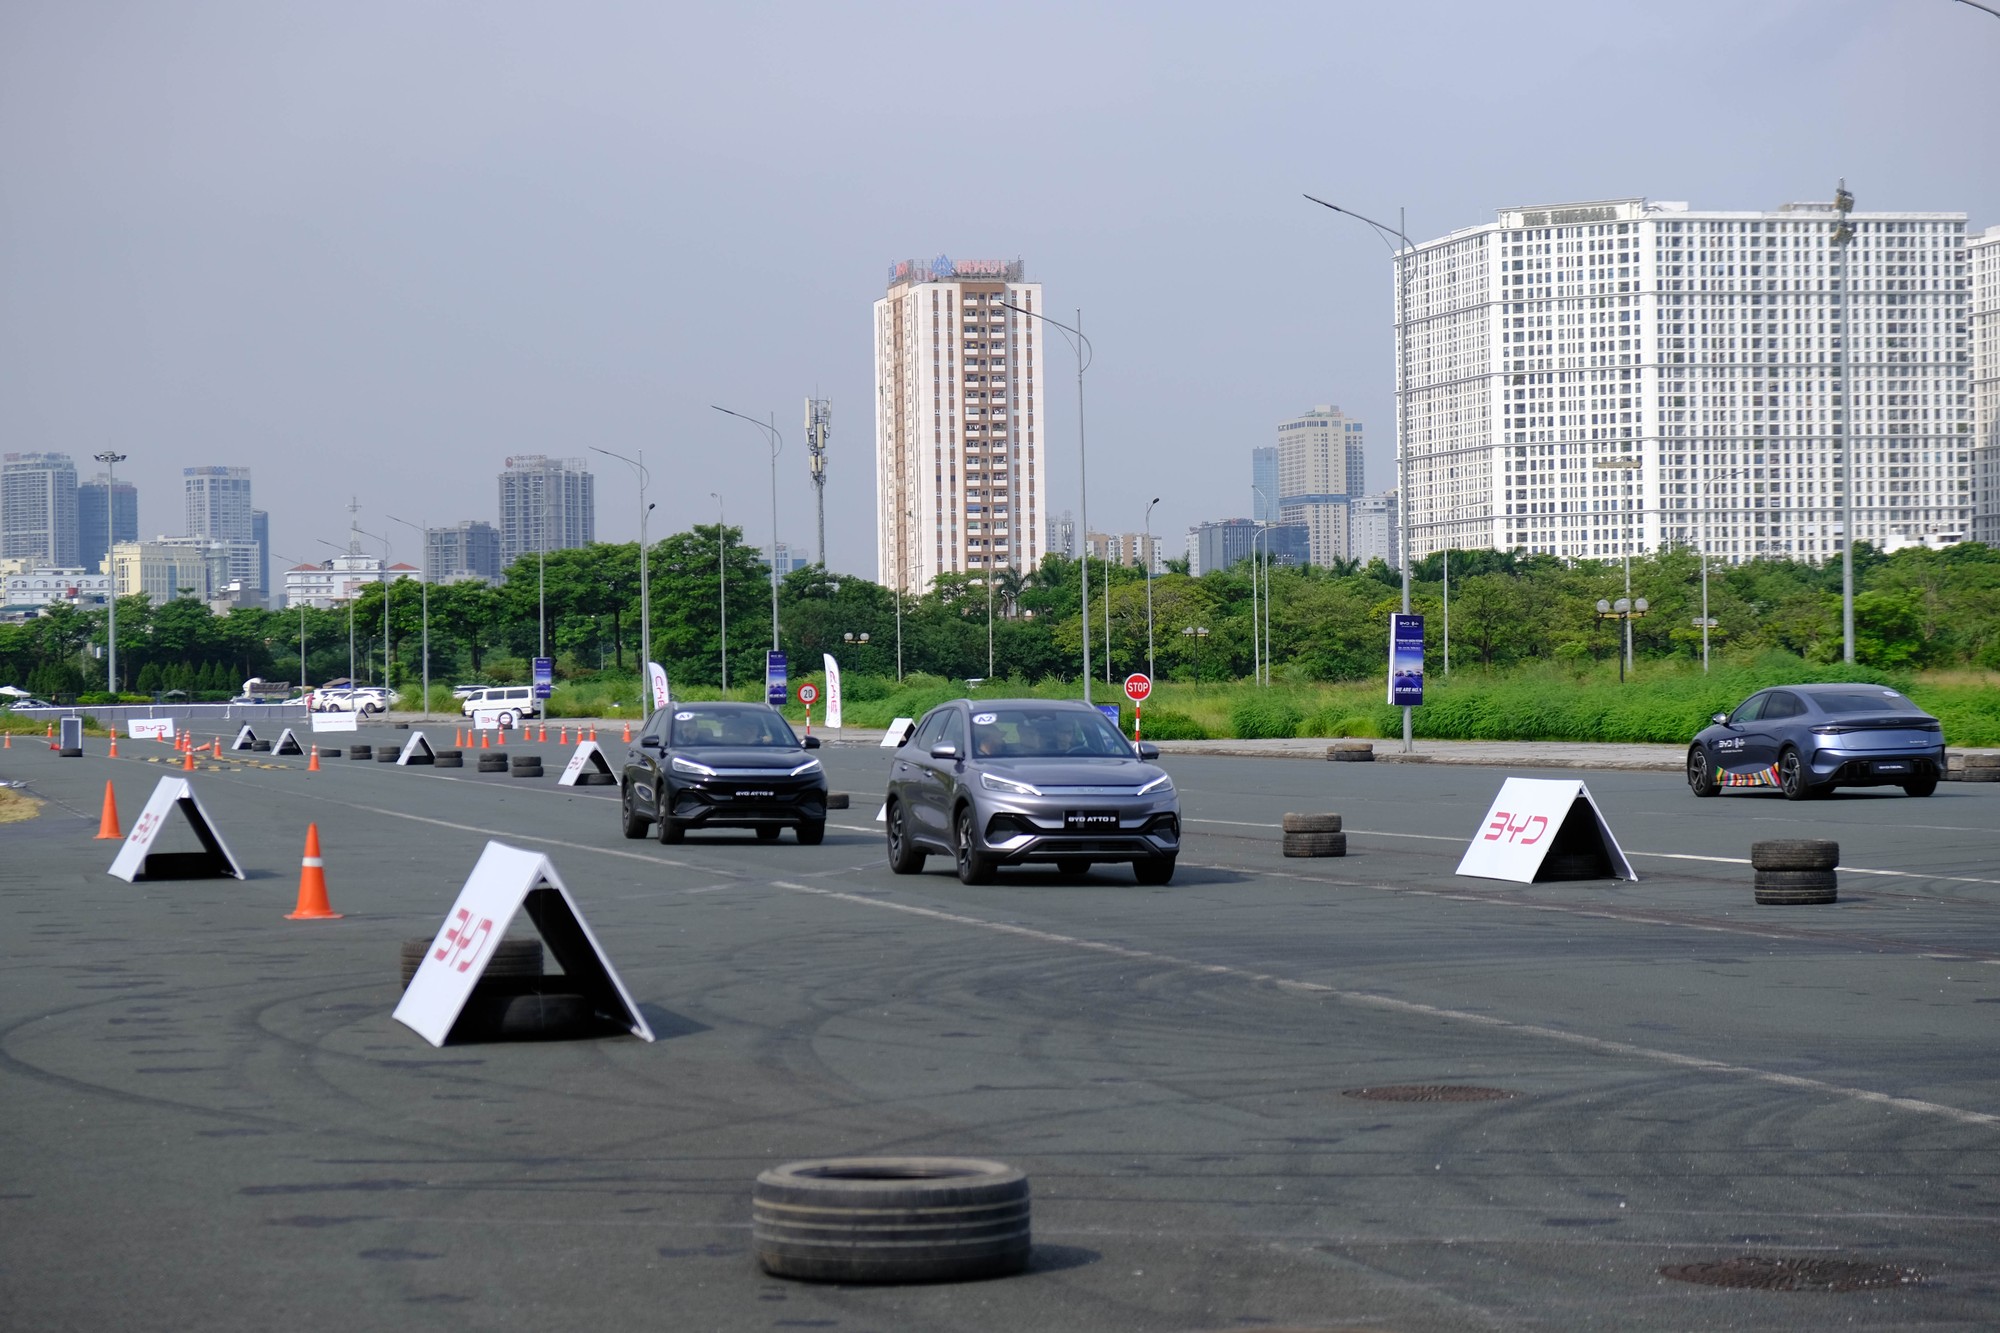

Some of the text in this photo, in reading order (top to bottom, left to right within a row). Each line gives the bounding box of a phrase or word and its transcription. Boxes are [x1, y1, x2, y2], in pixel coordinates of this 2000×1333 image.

[1127, 682, 1149, 692] STOP
[803, 689, 813, 699] 20
[1718, 740, 1733, 748] BYD
[1484, 811, 1548, 845] BYD
[434, 908, 493, 973] BYD
